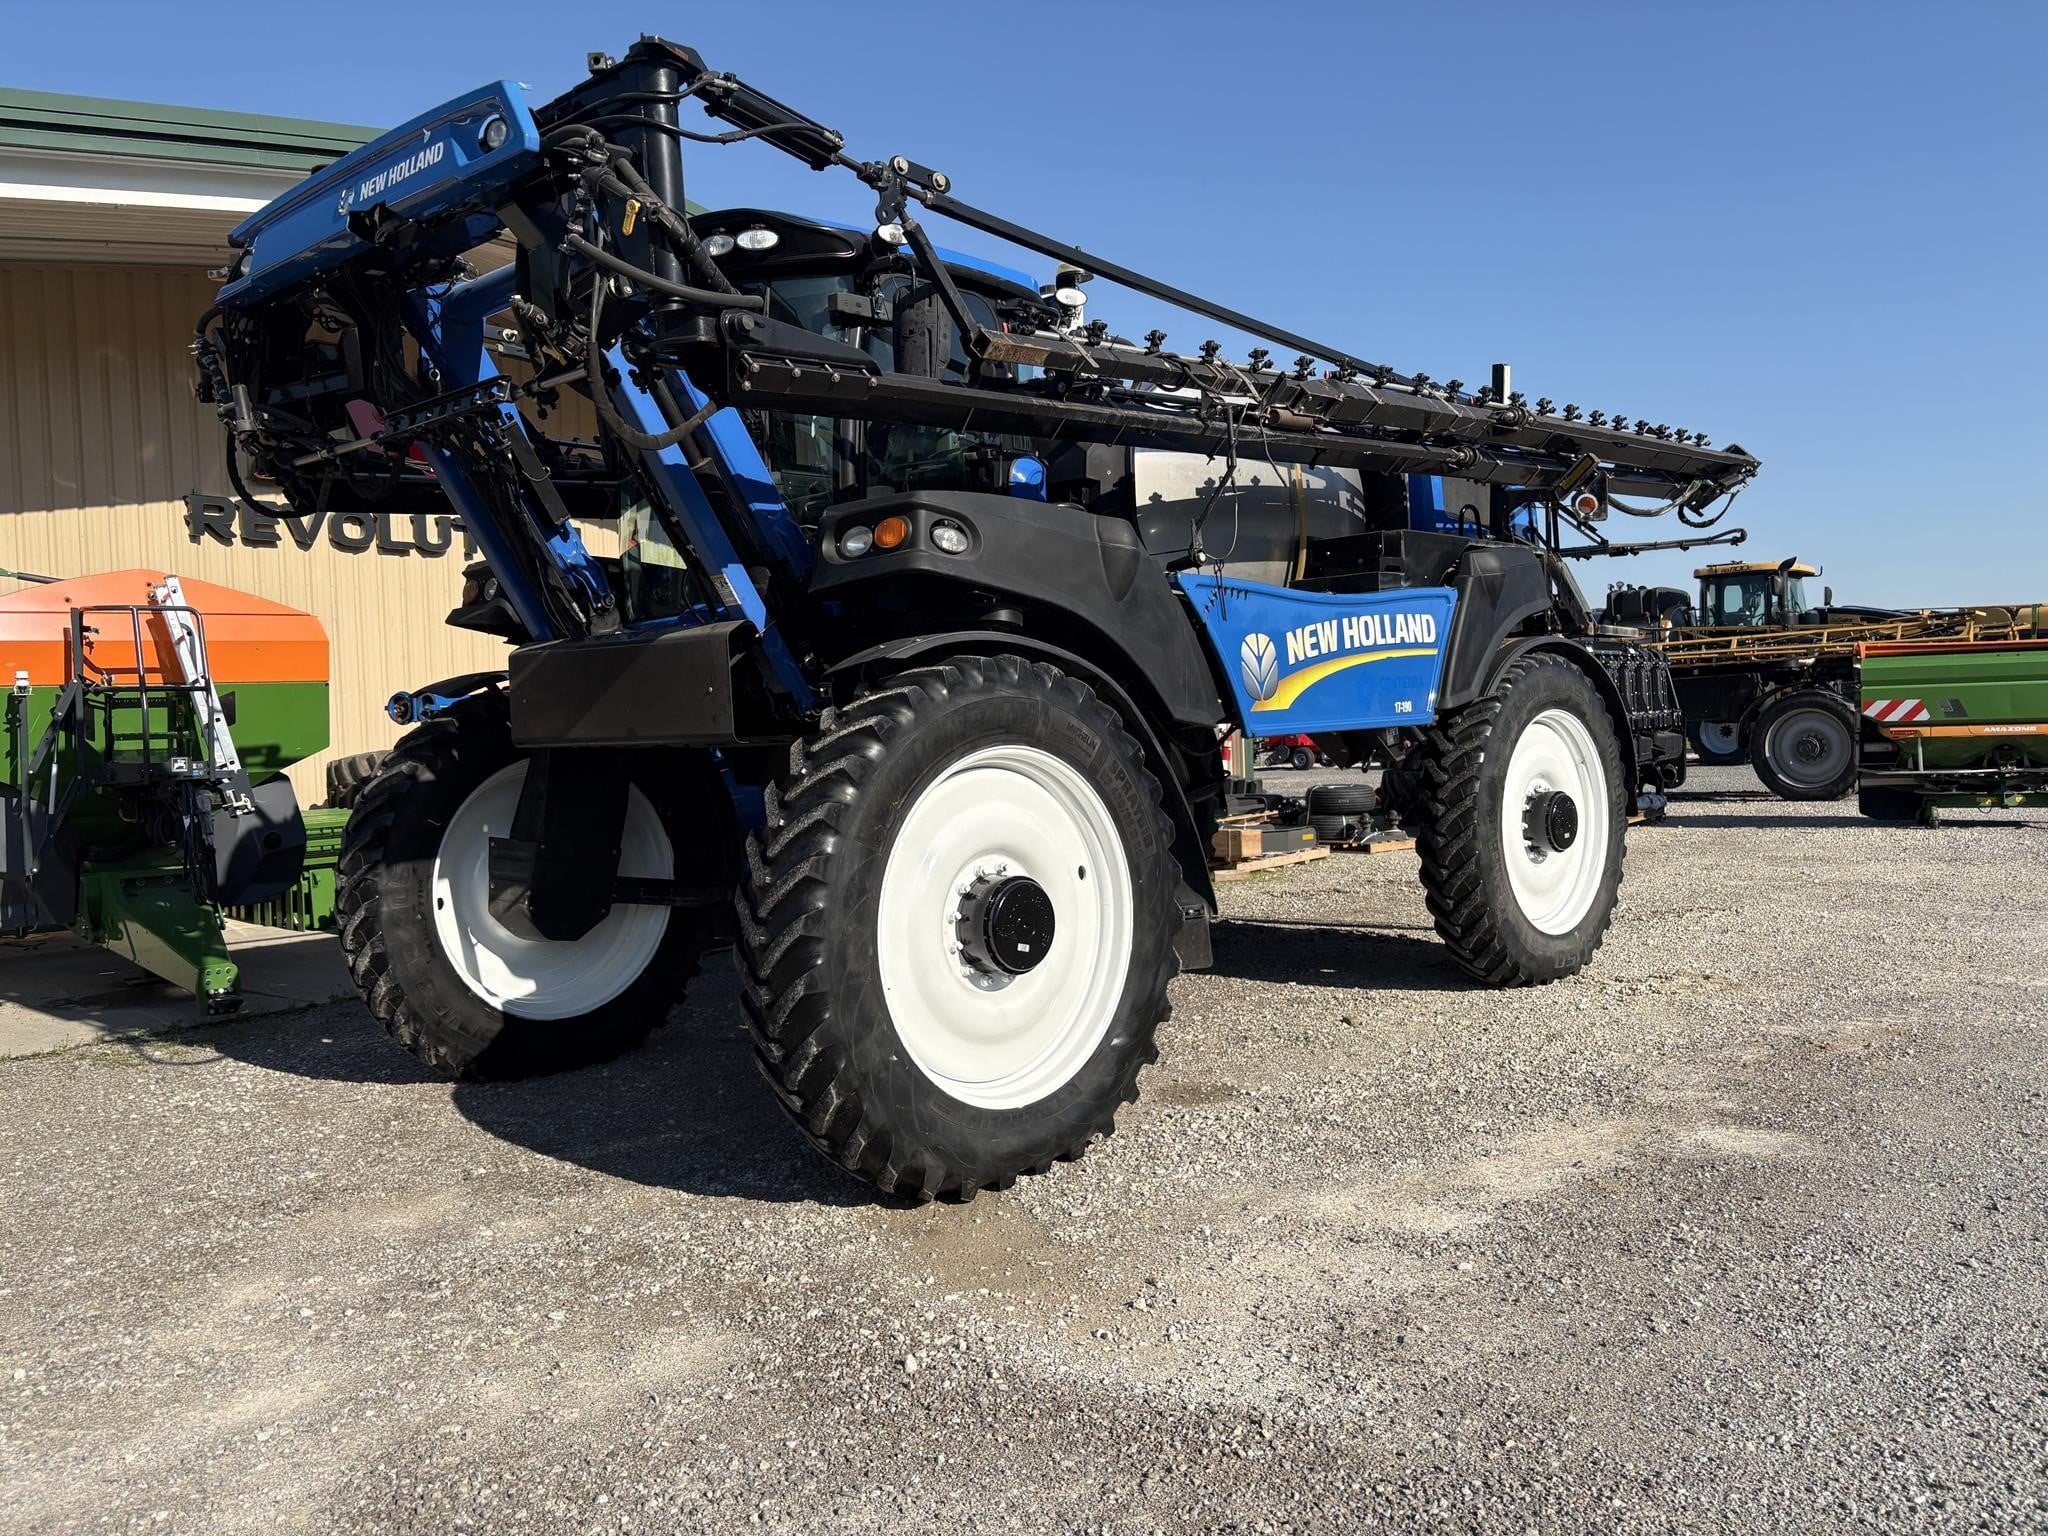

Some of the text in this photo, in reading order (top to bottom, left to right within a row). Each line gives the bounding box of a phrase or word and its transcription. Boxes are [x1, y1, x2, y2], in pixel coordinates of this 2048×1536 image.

[360, 142, 444, 201] NEW HOLLAND
[1286, 614, 1436, 665] NEW HOLLAND
[1983, 725, 2038, 733] AMAZONE
